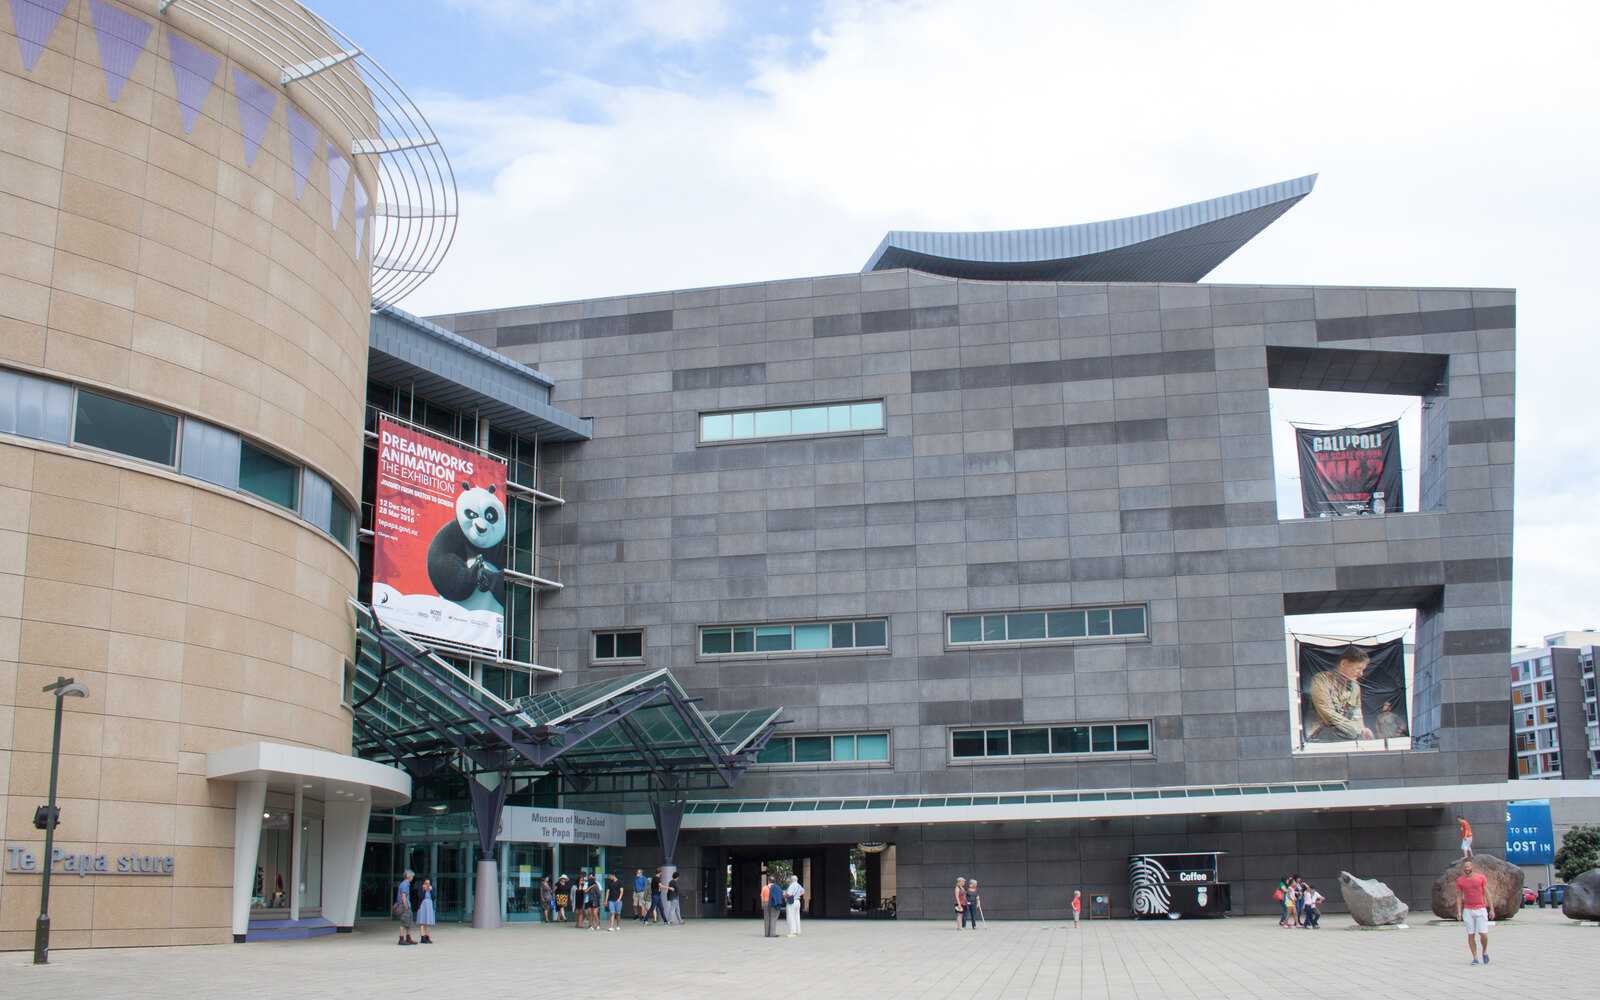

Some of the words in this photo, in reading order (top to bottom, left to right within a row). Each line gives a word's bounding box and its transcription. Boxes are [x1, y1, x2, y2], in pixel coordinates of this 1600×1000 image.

[1313, 433, 1382, 452] GALLIPOLI
[382, 430, 474, 475] DREAMWORKS
[1330, 450, 1355, 461] SCALE
[381, 446, 455, 483] ANIMATION
[381, 459, 400, 476] THE
[401, 467, 455, 494] EXHIBITION
[379, 506, 387, 515] 28
[388, 509, 400, 518] Mar
[401, 513, 415, 524] 2016
[380, 498, 388, 507] 12
[388, 501, 400, 511] Dec
[401, 505, 415, 516] 2015
[378, 518, 418, 536] tepapa.govt.nz
[532, 813, 564, 824] Museum
[566, 815, 573, 824] of
[574, 815, 586, 825] New
[586, 816, 606, 827] Zealand
[542, 827, 550, 837] Te
[552, 827, 571, 839] Papa
[574, 828, 600, 840] Tongarewa
[1505, 841, 1537, 852] LOST
[1540, 843, 1551, 852] IN
[7, 846, 36, 871] Te
[51, 846, 108, 877] Papa
[117, 852, 174, 873] store
[1180, 871, 1207, 881] Coffee
